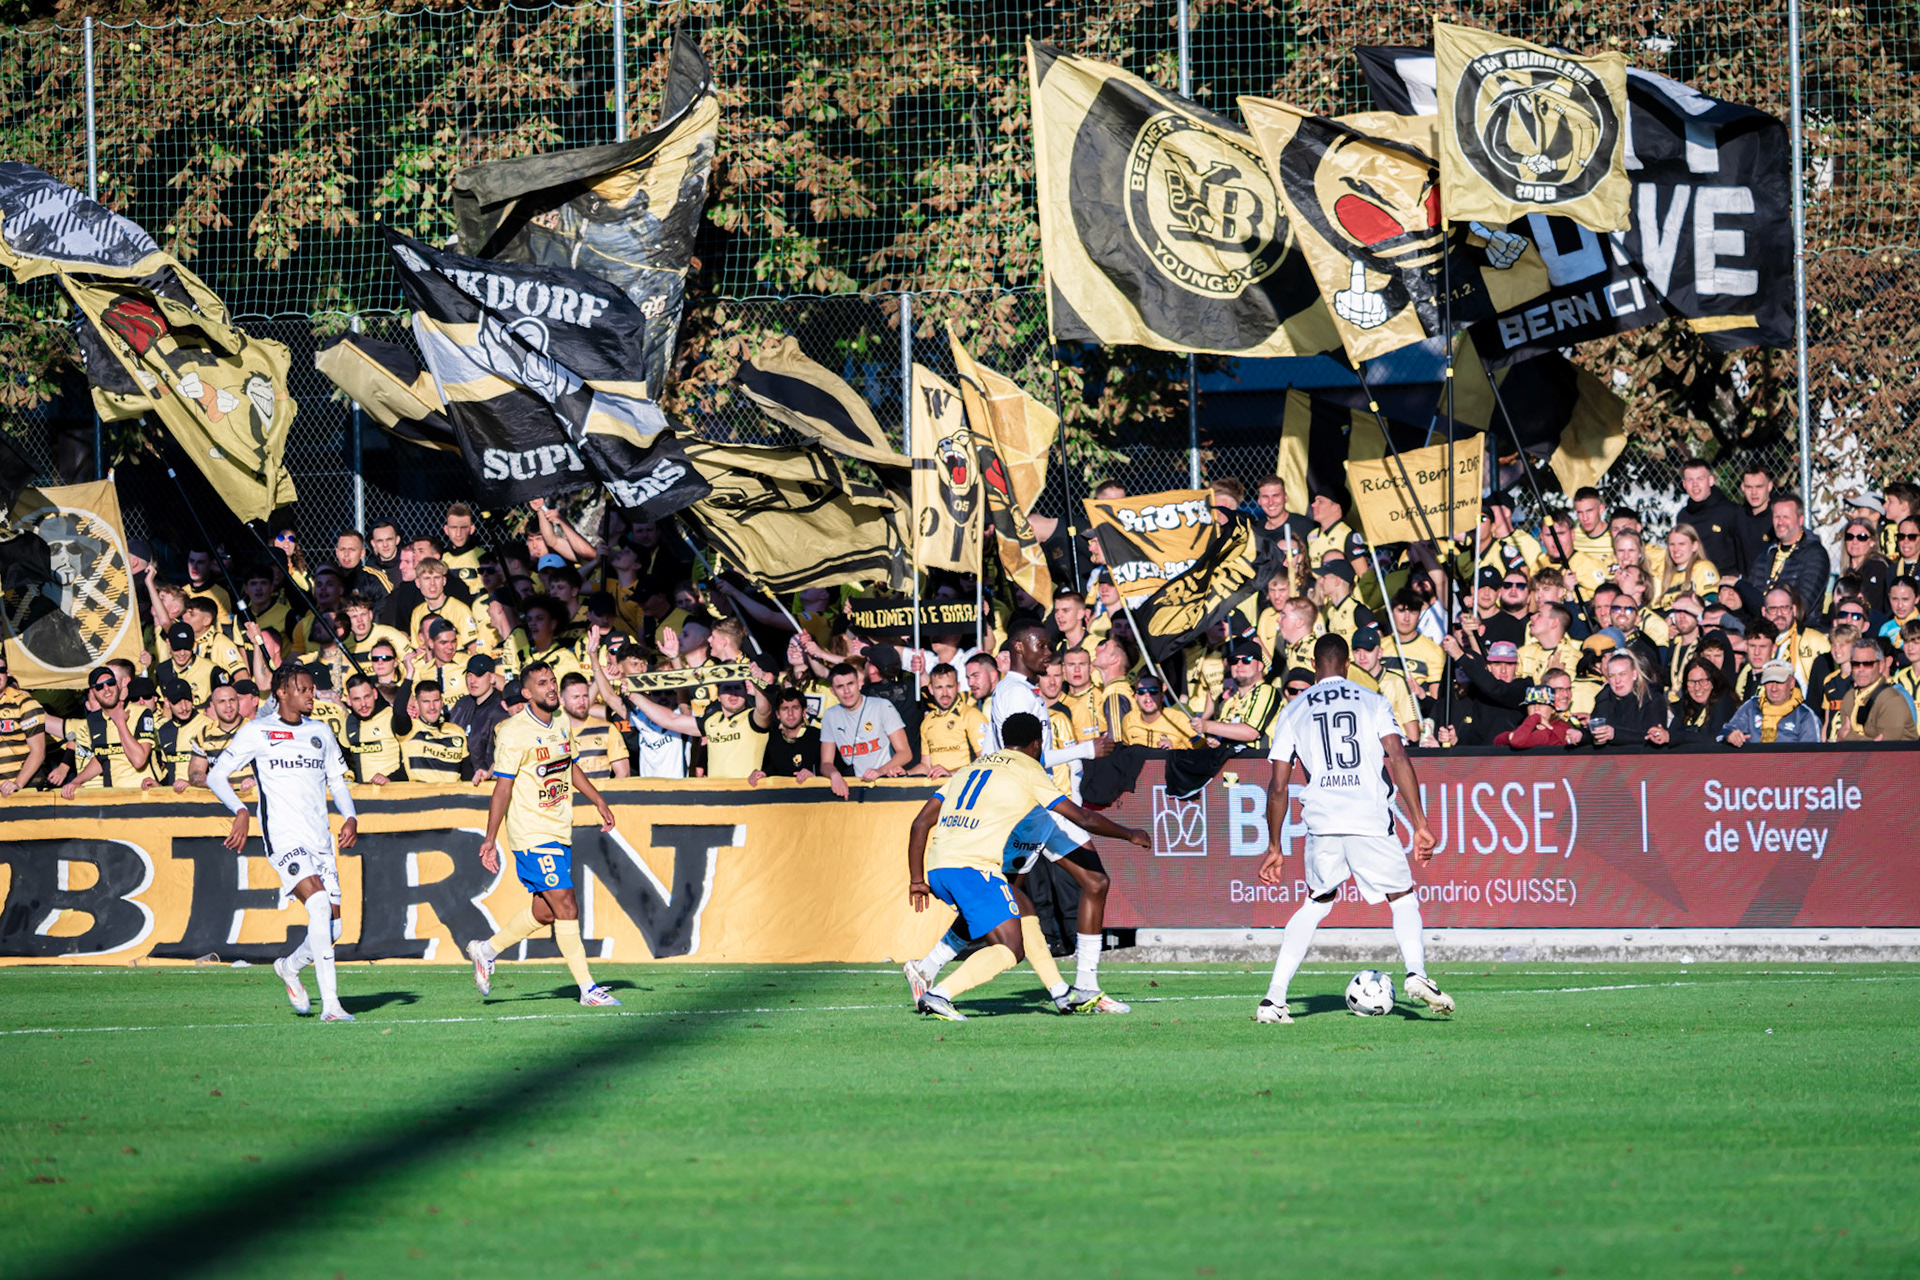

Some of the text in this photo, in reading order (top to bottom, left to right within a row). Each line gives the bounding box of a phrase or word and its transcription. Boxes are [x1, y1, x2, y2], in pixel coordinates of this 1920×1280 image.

[1504, 51, 1595, 85] RAMBLERS
[1515, 183, 1557, 201] 2009
[1152, 240, 1225, 292] YOUNG
[1497, 290, 1602, 350] BERN
[1360, 475, 1408, 494] Riots
[1415, 465, 1451, 485] Bern
[846, 605, 928, 629] CHILOMETI
[928, 605, 940, 623] E
[1306, 685, 1361, 707] kpt:
[839, 737, 882, 758] OBI
[1312, 710, 1363, 772] 13
[955, 768, 993, 811] 11
[1319, 774, 1361, 788] CAMARA
[1703, 777, 1863, 812] Succursale
[939, 814, 980, 830] MOBULU
[1393, 777, 1578, 860] SUISSE)
[1703, 819, 1829, 860] de Vevey
[537, 854, 557, 875] 19
[0, 823, 747, 963] BERN
[1229, 879, 1290, 903] Banca
[1485, 877, 1578, 907] (SUISSE)
